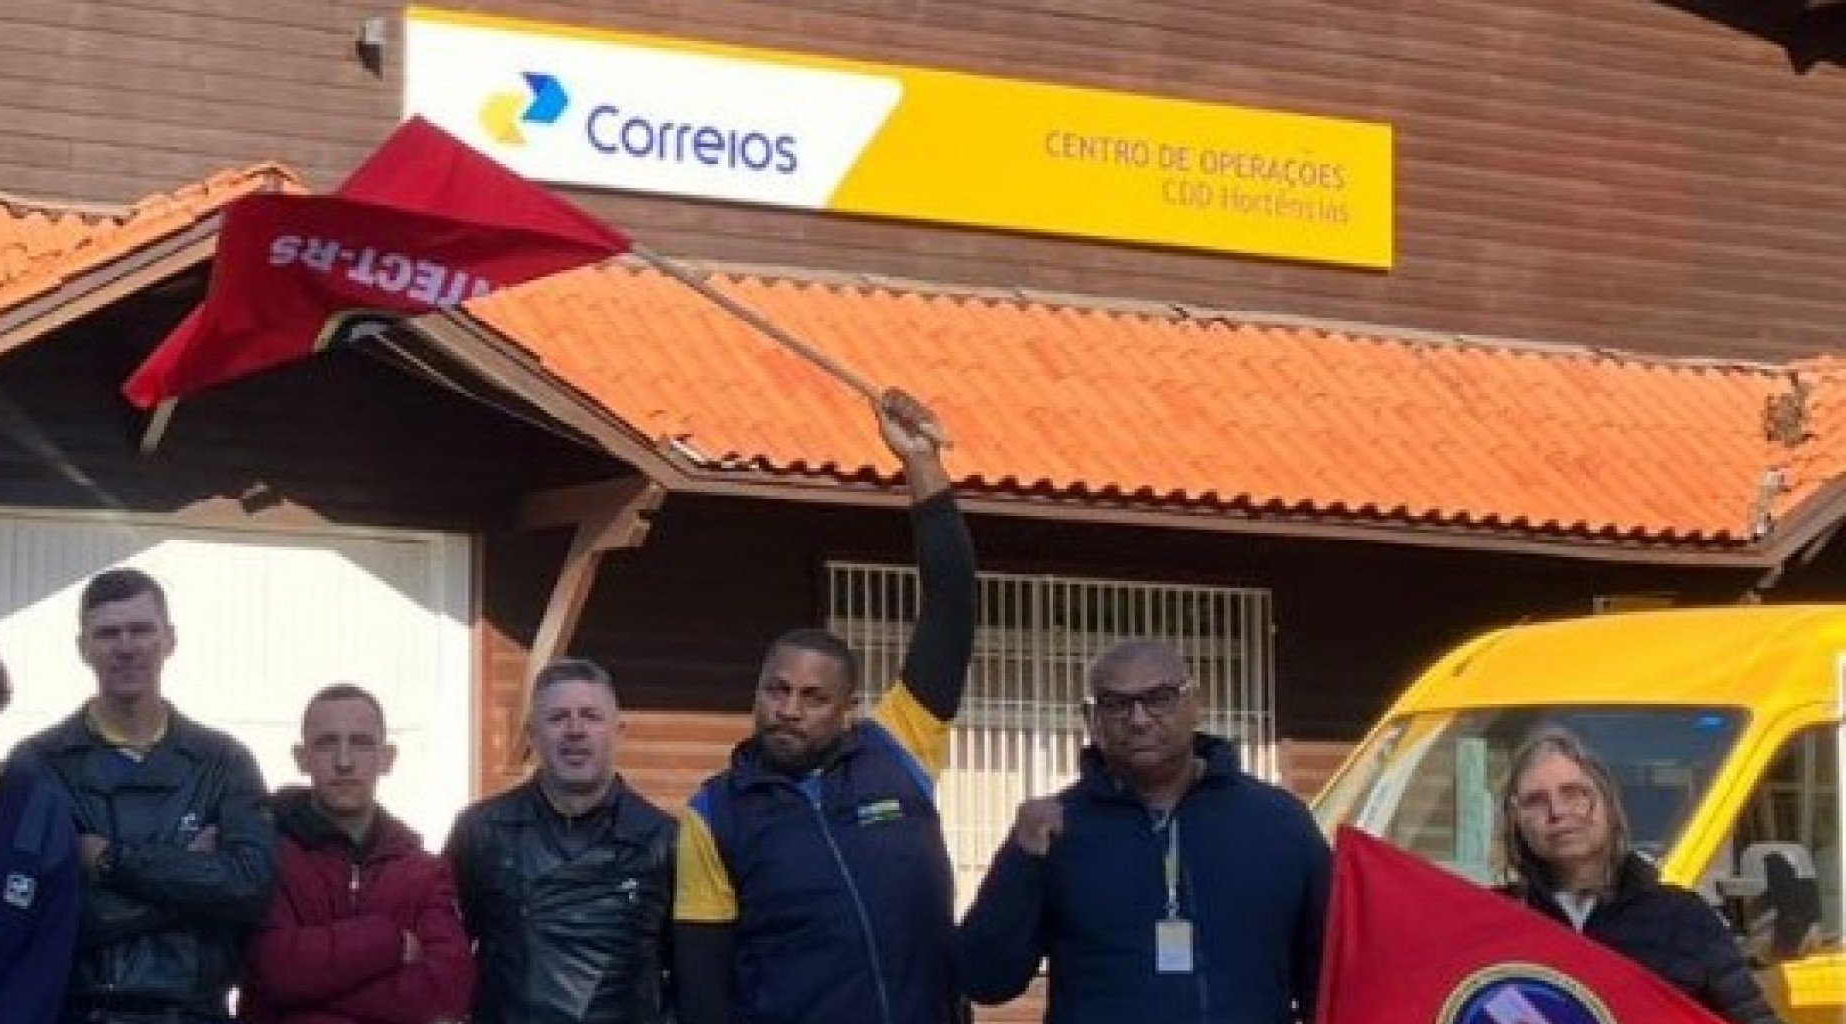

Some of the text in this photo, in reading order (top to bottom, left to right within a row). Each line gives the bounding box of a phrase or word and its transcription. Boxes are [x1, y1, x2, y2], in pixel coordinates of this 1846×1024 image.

[585, 105, 799, 174] Correios
[1045, 130, 1345, 189] CENTRO DE OPERAÇÕES
[1162, 179, 1213, 208] CDD
